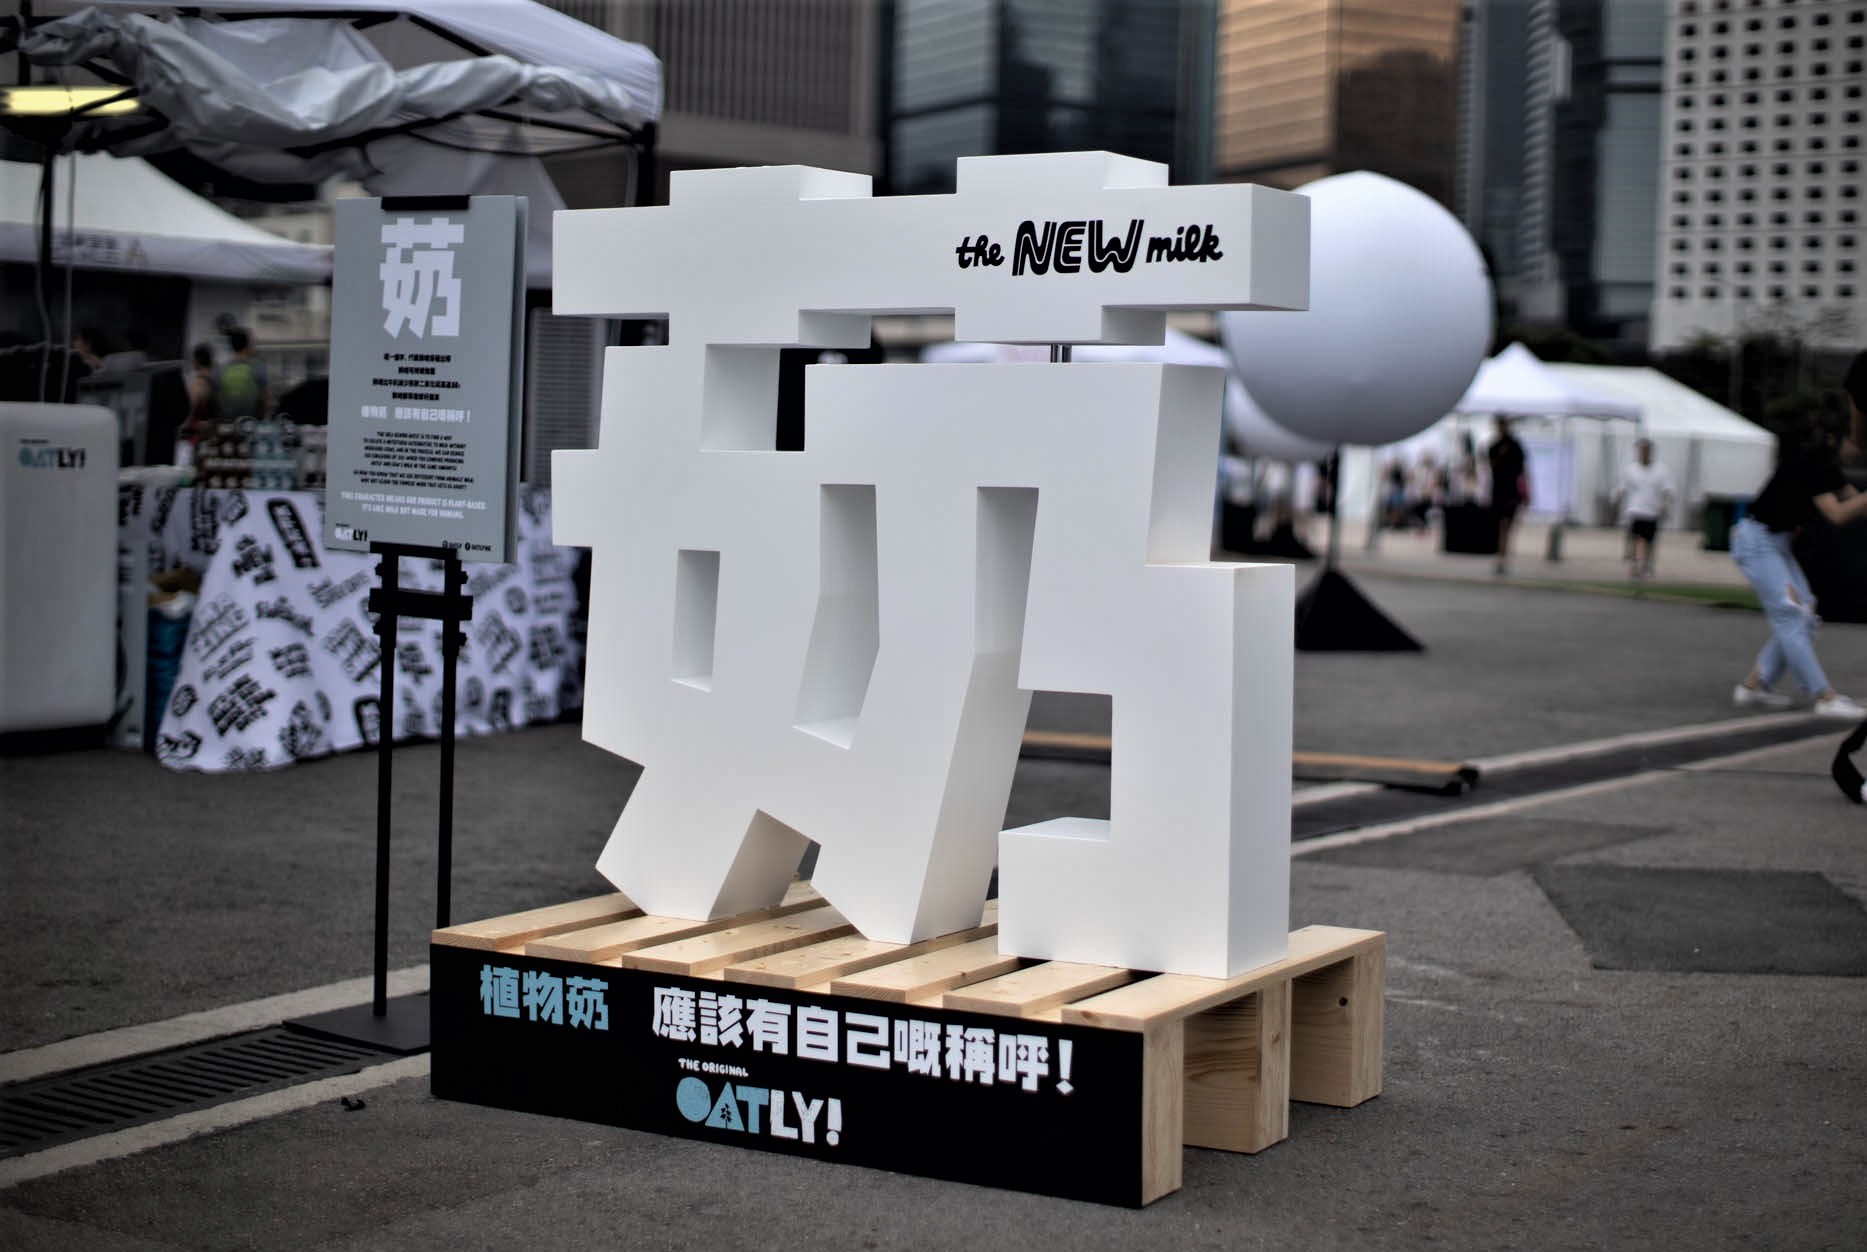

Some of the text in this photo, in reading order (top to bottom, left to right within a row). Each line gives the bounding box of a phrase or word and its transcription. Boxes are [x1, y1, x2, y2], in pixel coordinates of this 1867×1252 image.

[956, 219, 1224, 277] the NEW milk
[678, 1058, 749, 1077] THE ORIGINAL
[676, 1076, 843, 1146] OATLY!
